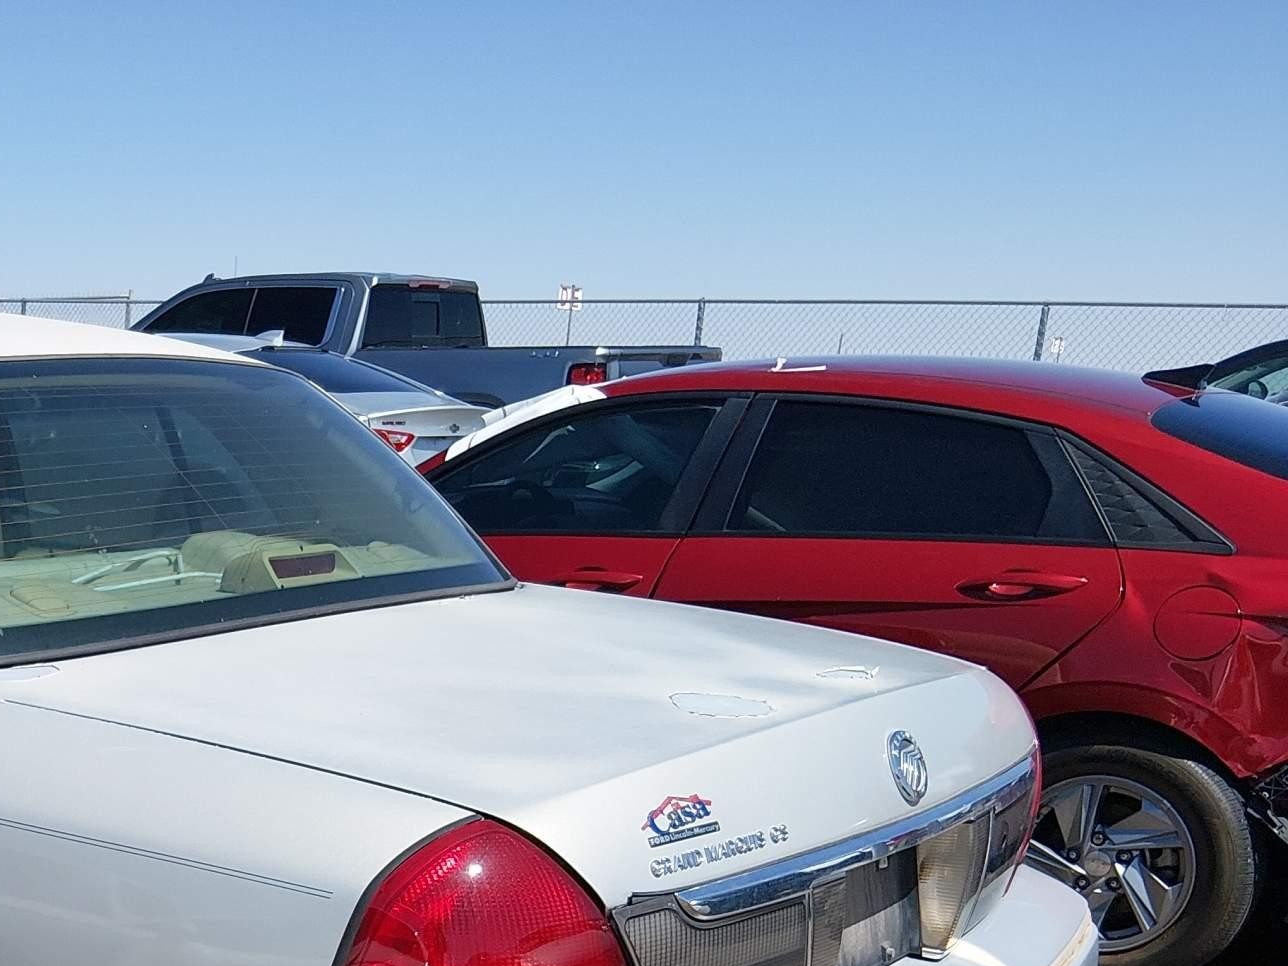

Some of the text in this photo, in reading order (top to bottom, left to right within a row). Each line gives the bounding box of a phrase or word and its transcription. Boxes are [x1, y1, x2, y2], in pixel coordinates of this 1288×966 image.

[647, 801, 711, 835] Casa
[650, 849, 703, 878] GRAND
[704, 831, 766, 863] MARQUIS
